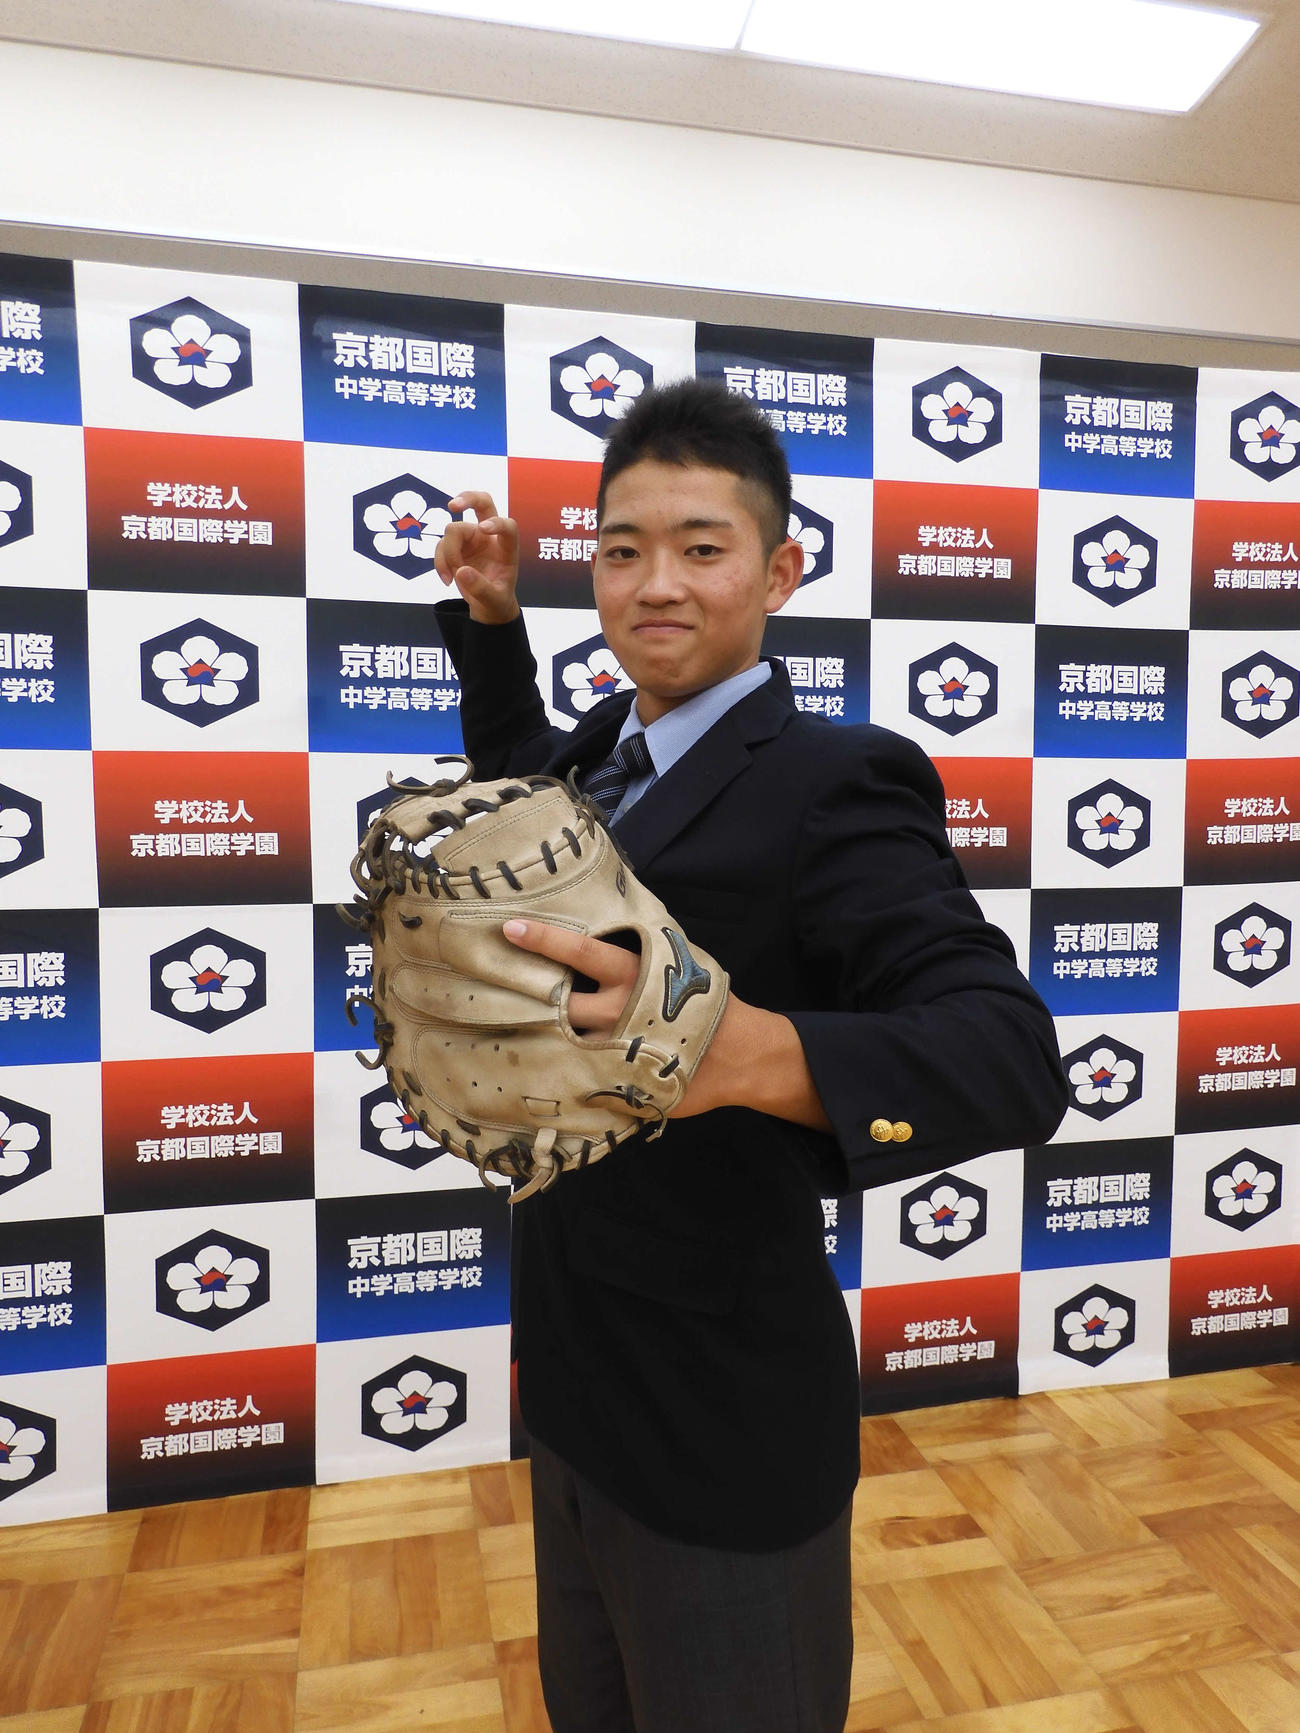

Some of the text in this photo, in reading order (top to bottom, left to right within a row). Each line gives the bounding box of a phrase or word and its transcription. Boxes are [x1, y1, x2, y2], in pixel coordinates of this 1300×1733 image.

[332, 332, 475, 378] 京都国際
[335, 375, 476, 409] 中学高等学校
[724, 366, 847, 406] 京都国際
[758, 408, 847, 436] 高等学校
[1065, 394, 1173, 431] 京都国際
[1065, 432, 1172, 459] 中学高等学校
[147, 482, 248, 510] 学校法人
[121, 515, 272, 545] 京都国際学園
[918, 526, 993, 549] 学校法人
[1232, 542, 1298, 562] 学校法人
[898, 554, 1011, 579] 京都国際学園
[1214, 569, 1300, 589] 京都国際学
[772, 656, 845, 688] 国際
[1059, 663, 1165, 695] 京都国際
[0, 678, 55, 703] 学校
[341, 686, 461, 711] 中学高等学
[1059, 700, 1164, 721] 中学高等学校
[155, 800, 253, 823] 学校法人
[1224, 797, 1289, 817] 学校法人
[130, 833, 278, 857] 京都国際学園
[946, 827, 1007, 847] 際学園
[1054, 922, 1158, 952] 京都国際
[1054, 957, 1157, 979] 中学高等学校
[1216, 1044, 1281, 1065] 学校法人
[1199, 1068, 1296, 1093] 京都国際学園
[161, 1102, 258, 1128] 学校法人
[136, 1132, 282, 1162] 京都国際学園
[1047, 1173, 1150, 1207] 京都国際
[1047, 1207, 1149, 1232] 中学高等学校
[348, 1228, 482, 1268] 京都国際
[0, 1262, 72, 1300] 国際
[349, 1266, 482, 1297] 中学高等学校
[1208, 1285, 1272, 1308] 学校法人
[904, 1317, 977, 1342] 学校法人
[1191, 1308, 1288, 1335] 京都国際学園
[886, 1341, 994, 1371] 京都国際学園
[165, 1395, 260, 1425] 学校法人
[141, 1423, 284, 1459] 京都国際学園
